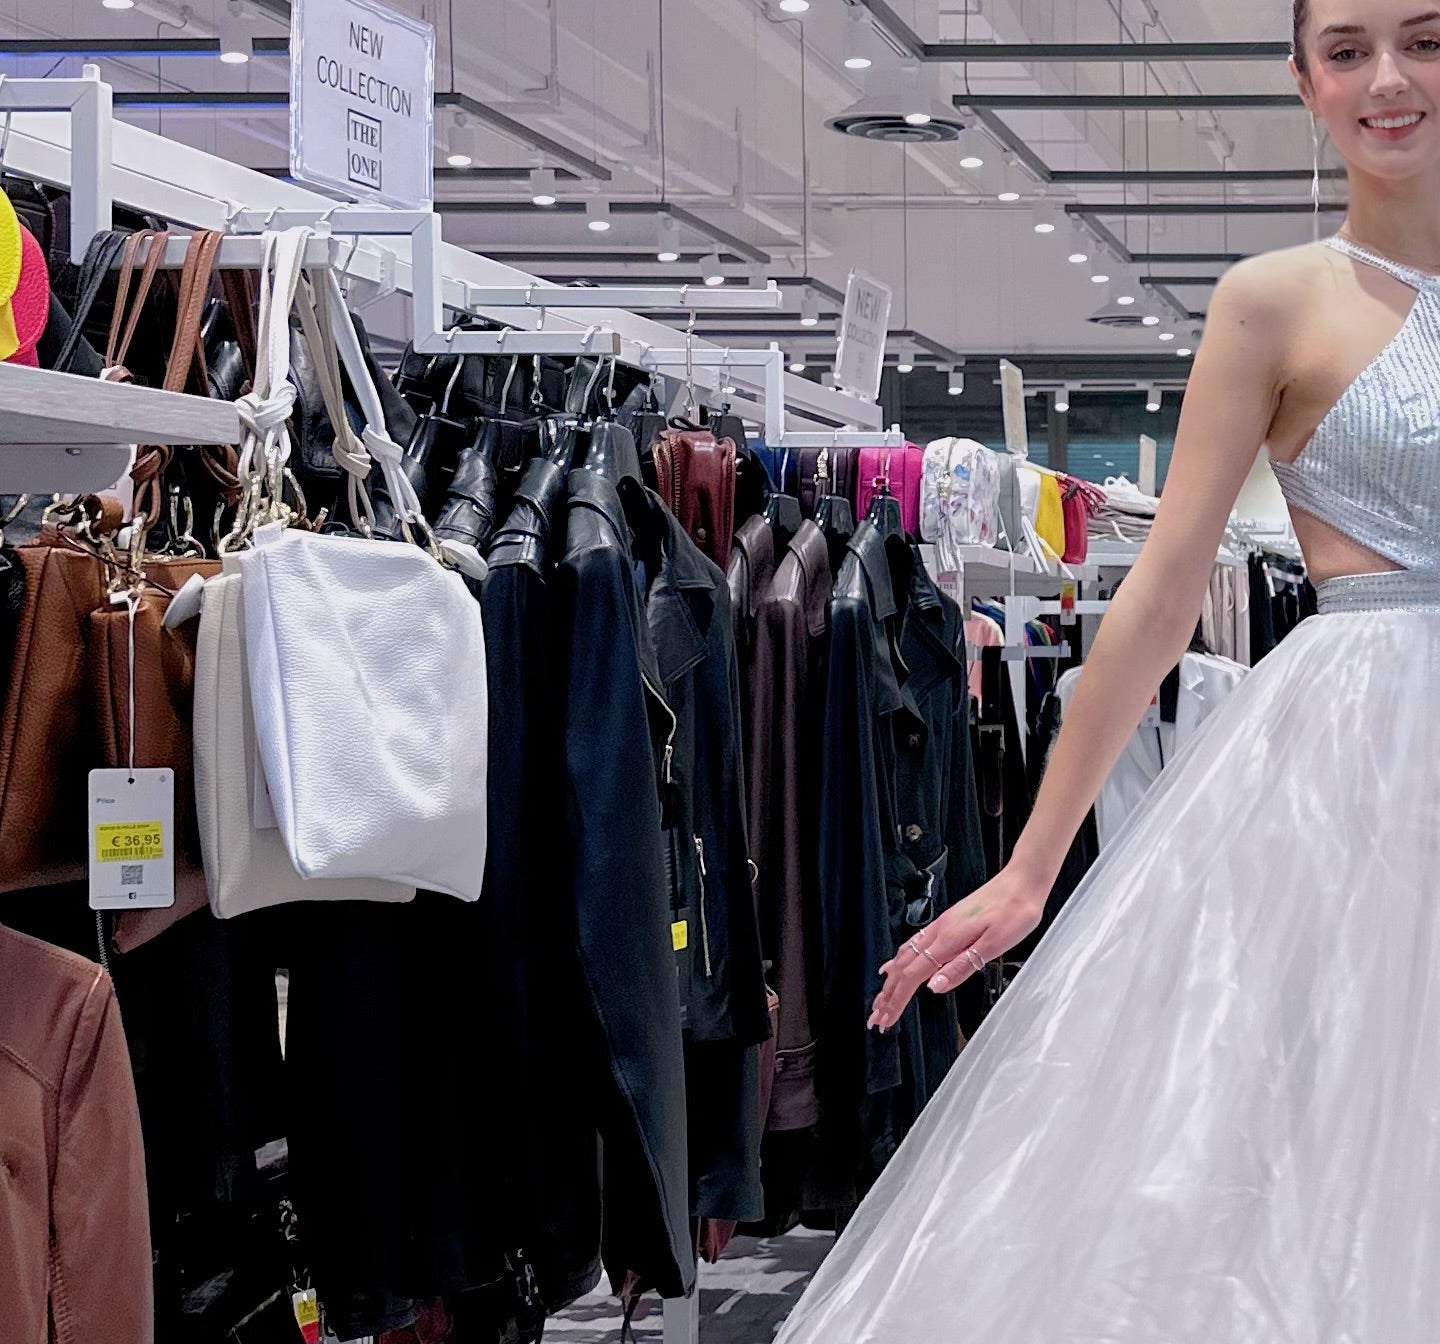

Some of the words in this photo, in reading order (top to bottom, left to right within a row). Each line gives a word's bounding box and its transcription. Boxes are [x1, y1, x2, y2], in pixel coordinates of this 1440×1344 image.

[349, 21, 384, 60] NEW
[317, 56, 411, 117] COLLECTION
[351, 119, 379, 148] THE
[351, 153, 379, 181] ONE
[856, 288, 881, 322] NEW
[112, 836, 120, 847] €
[124, 834, 160, 847] 36,95
